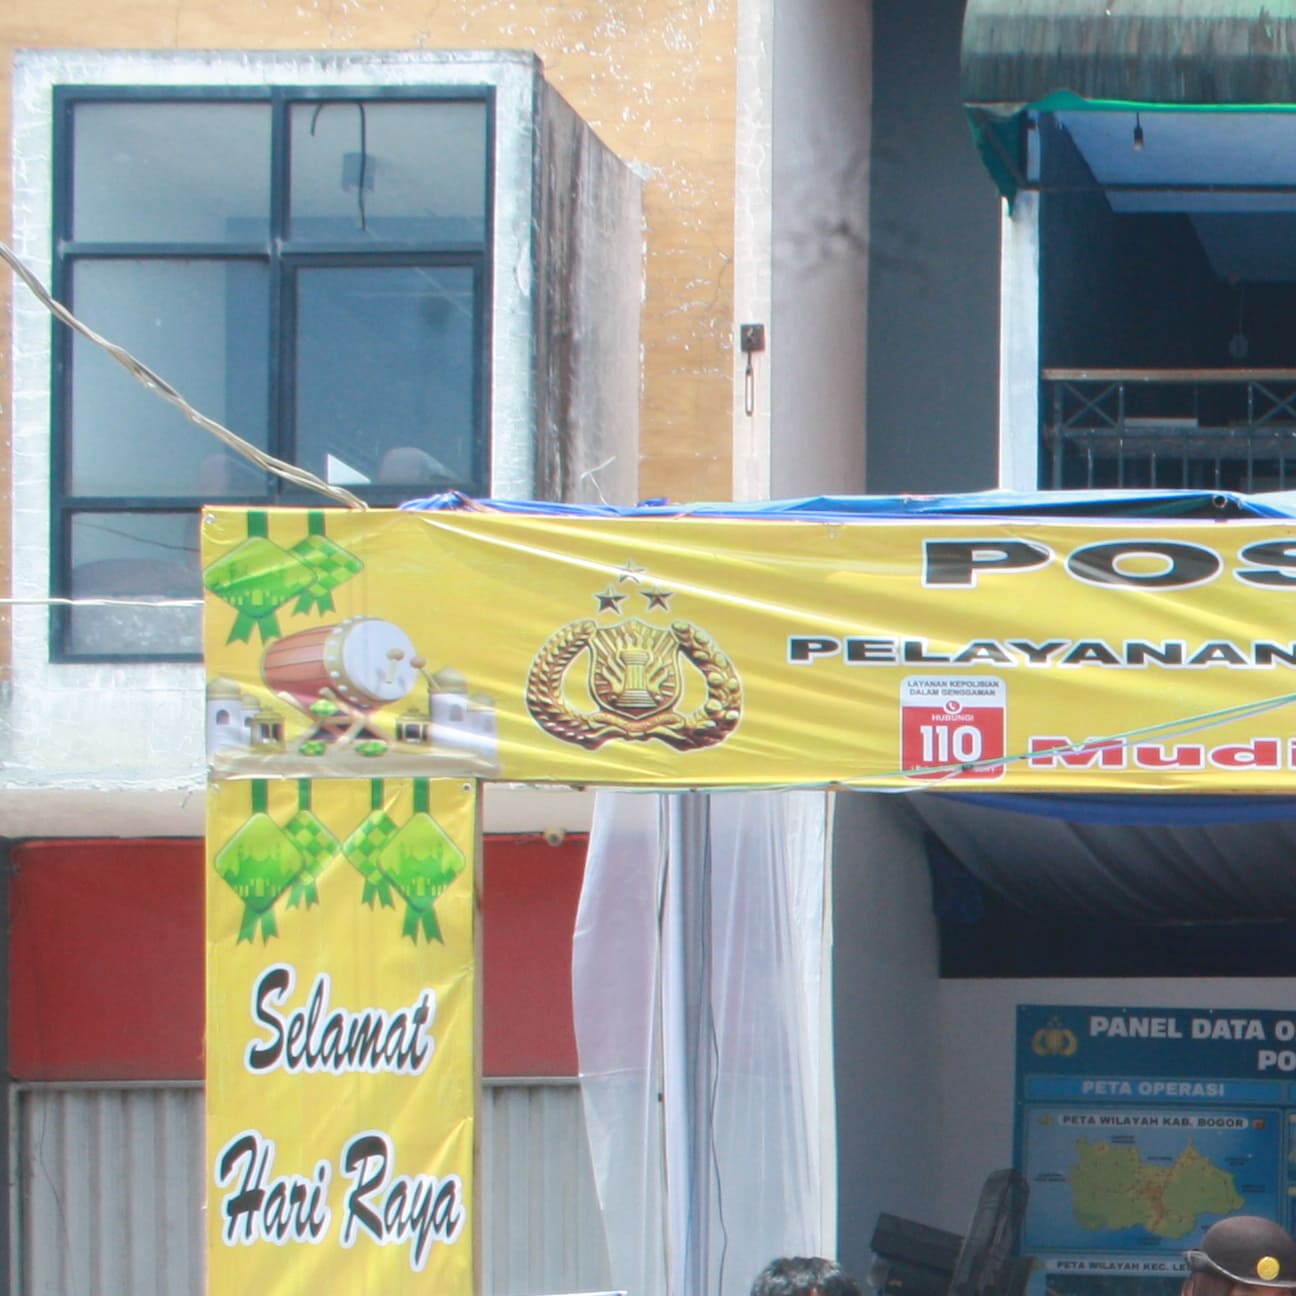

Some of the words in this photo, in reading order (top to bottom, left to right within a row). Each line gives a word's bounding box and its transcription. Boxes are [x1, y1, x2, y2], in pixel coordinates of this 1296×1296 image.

[908, 680, 948, 688] LAYANAN
[949, 680, 1000, 688] KEPOLISIAN
[931, 713, 975, 721] HUBUNGI
[920, 725, 982, 762] 110
[247, 965, 433, 1073] Selamat
[1089, 1016, 1183, 1039] PANEL
[1191, 1018, 1266, 1041] DATA
[1082, 1080, 1132, 1095] PETA
[1138, 1082, 1225, 1097] OPERASI
[1062, 1114, 1097, 1125] PETA
[1099, 1115, 1159, 1127] WILAYAH
[1162, 1117, 1193, 1128] KAB.
[1197, 1118, 1244, 1129] BOGOR
[219, 1133, 329, 1241] Hari
[344, 1135, 459, 1268] Raya
[1056, 1260, 1088, 1271] PETA
[1089, 1261, 1140, 1272] WILAYAH
